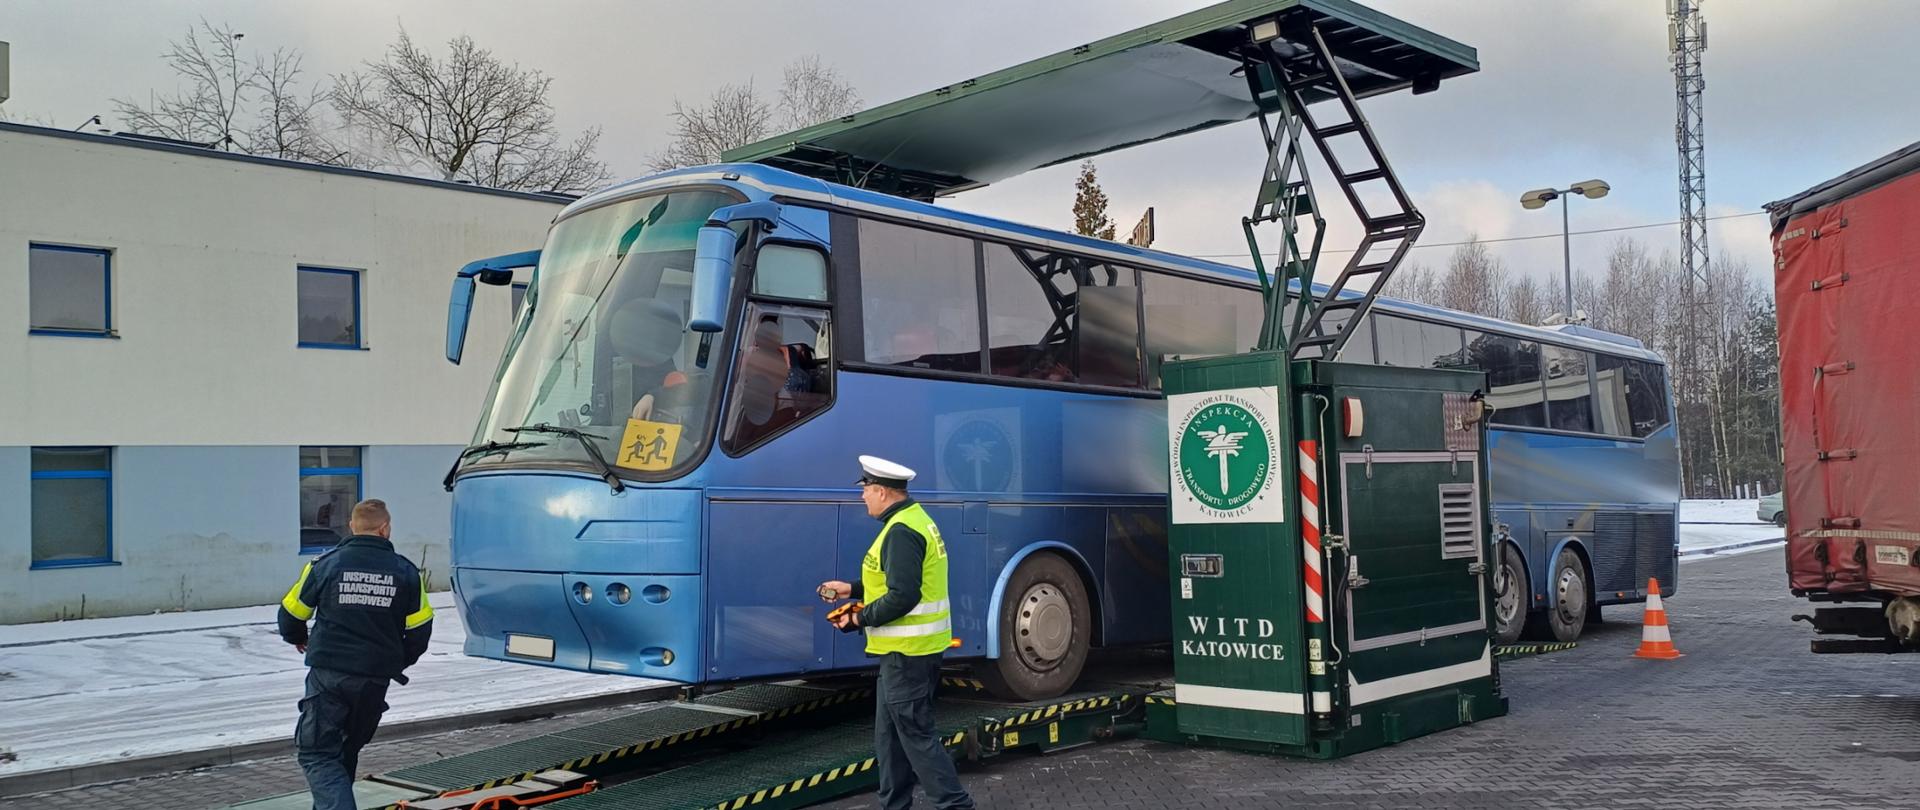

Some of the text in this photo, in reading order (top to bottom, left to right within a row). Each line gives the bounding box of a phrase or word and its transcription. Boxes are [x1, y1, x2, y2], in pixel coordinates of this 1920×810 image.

[1190, 407, 1253, 432] INSPEKCJA
[1179, 395, 1222, 430] INSPEKTORAT
[1225, 395, 1268, 427] TRANSPORTU
[1265, 429, 1276, 490] DROGOWEGO
[1185, 463, 1265, 505] TRANSPORTU DROGOWEGO
[1200, 504, 1253, 518] KATOWICE
[343, 571, 393, 585] INSPEKCJA
[339, 582, 396, 596] TRANSPORTU
[339, 594, 392, 607] DROGOWEGO
[1182, 640, 1284, 660] KATOWICE
